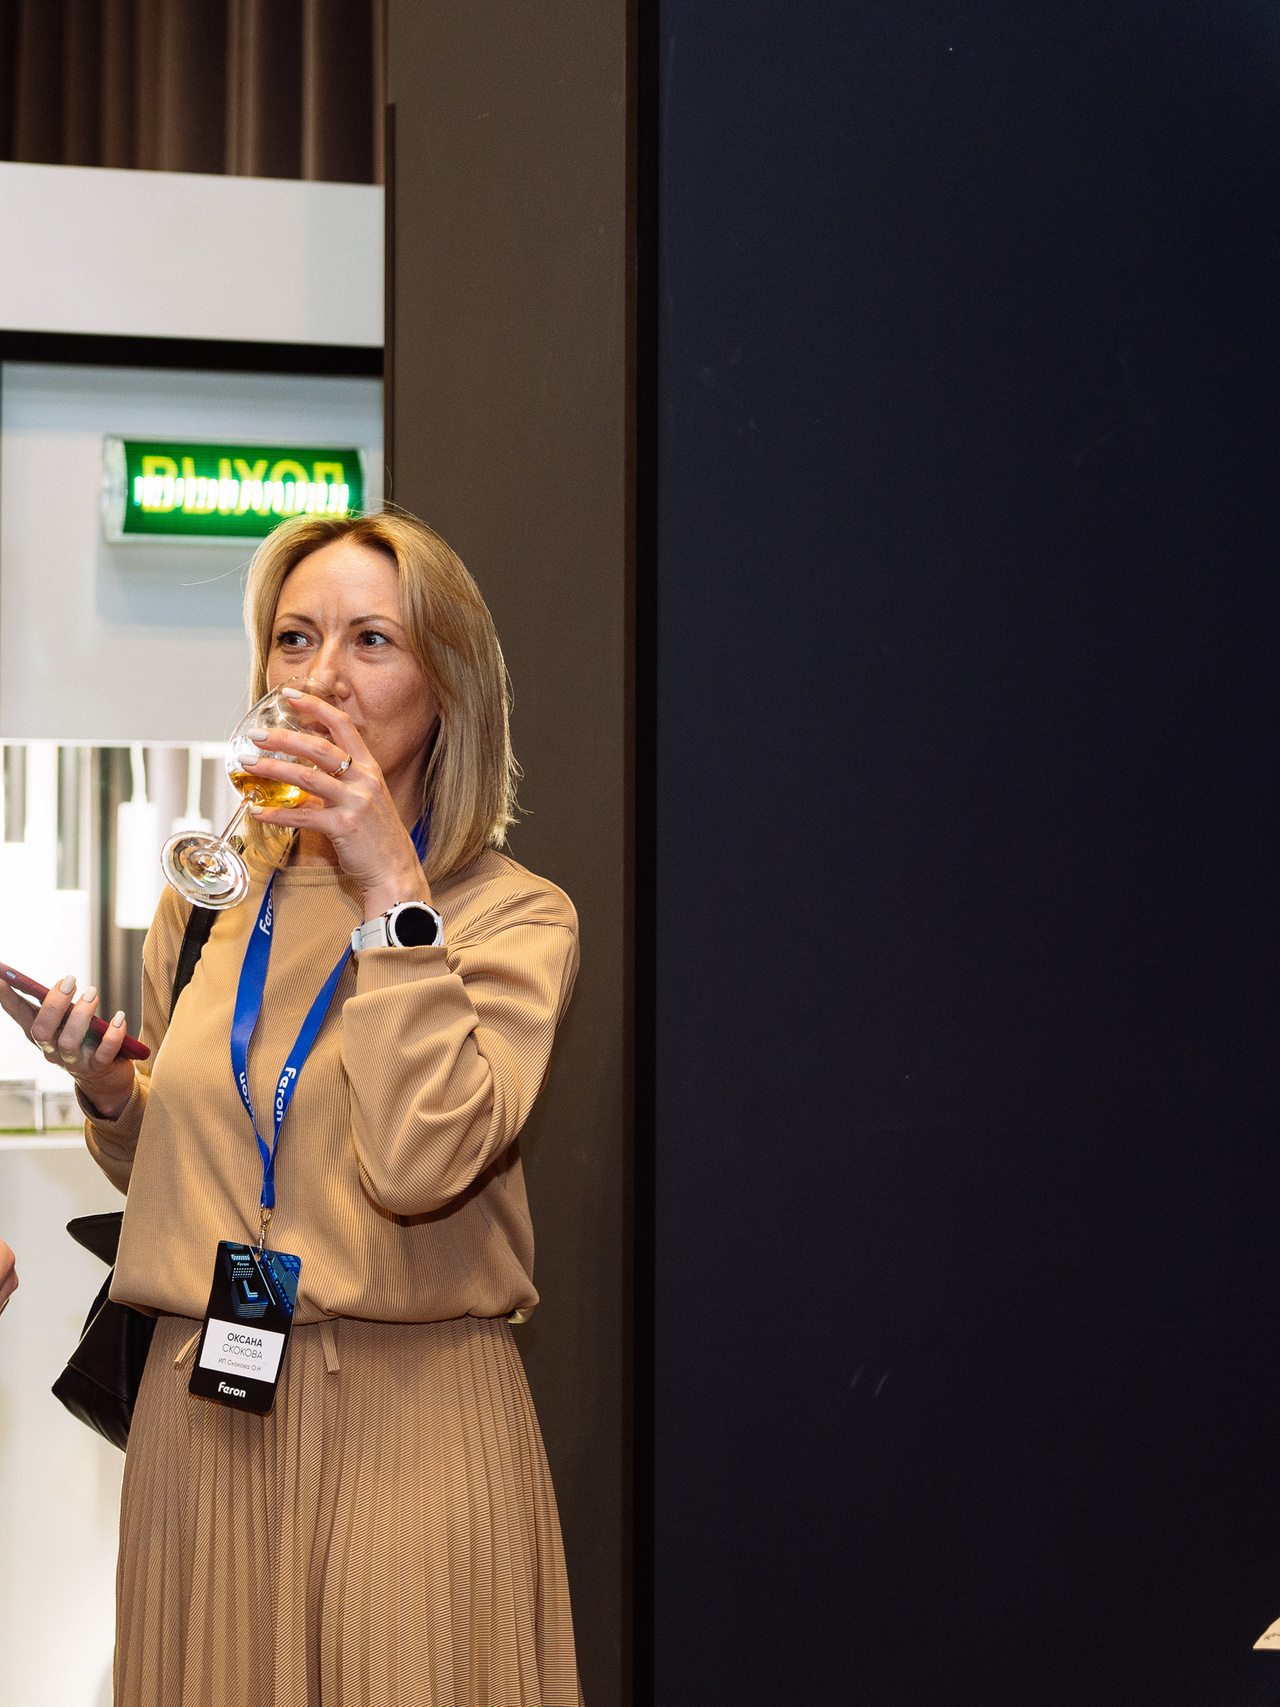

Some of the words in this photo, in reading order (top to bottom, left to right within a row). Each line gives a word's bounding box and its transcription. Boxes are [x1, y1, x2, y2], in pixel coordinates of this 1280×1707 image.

[141, 455, 349, 517] ВЫХОД
[276, 1066, 297, 1122] Feron
[227, 1332, 263, 1348] ОКСАНА
[222, 1343, 263, 1360] СКОКОВА
[217, 1381, 247, 1398] Feron
